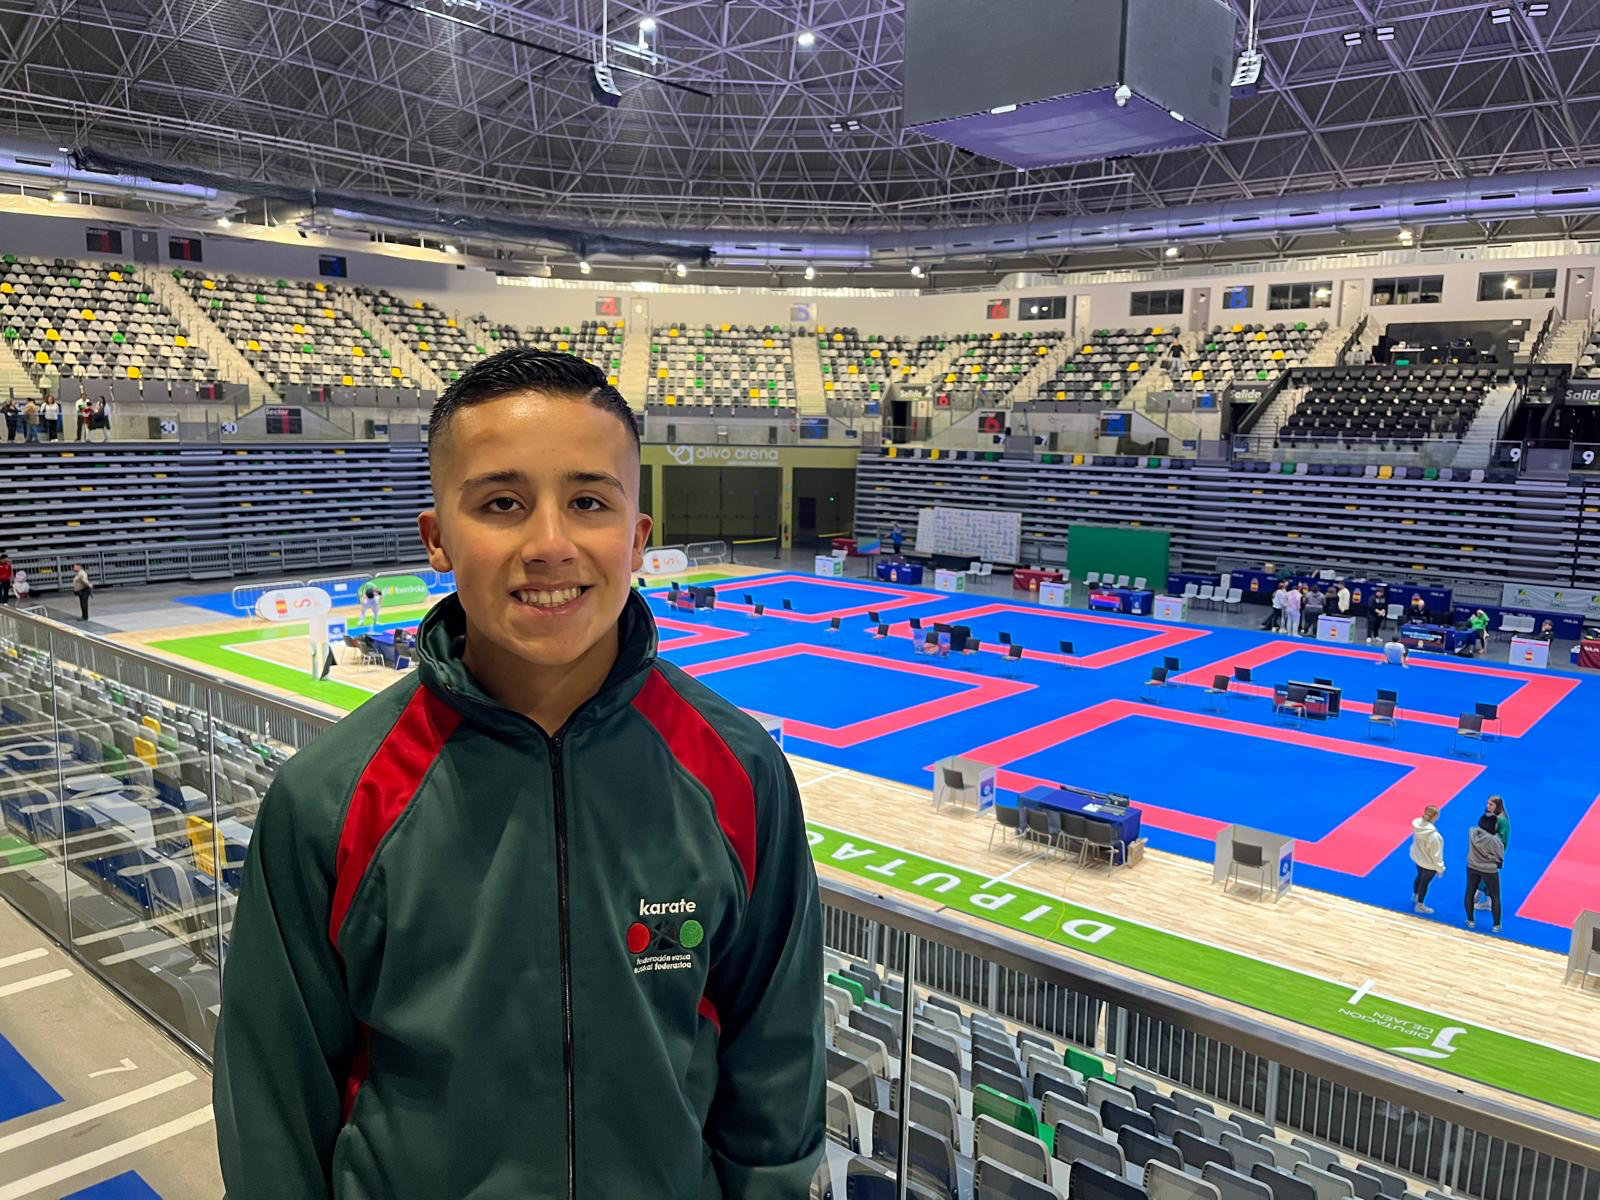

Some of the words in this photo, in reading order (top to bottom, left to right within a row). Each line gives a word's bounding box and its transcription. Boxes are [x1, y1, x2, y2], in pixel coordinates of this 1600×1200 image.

[697, 446, 731, 460] olivo
[735, 448, 779, 460] arena
[1509, 448, 1521, 462] 9
[1582, 450, 1595, 465] 9
[639, 898, 697, 916] karate
[672, 953, 691, 962] vasca
